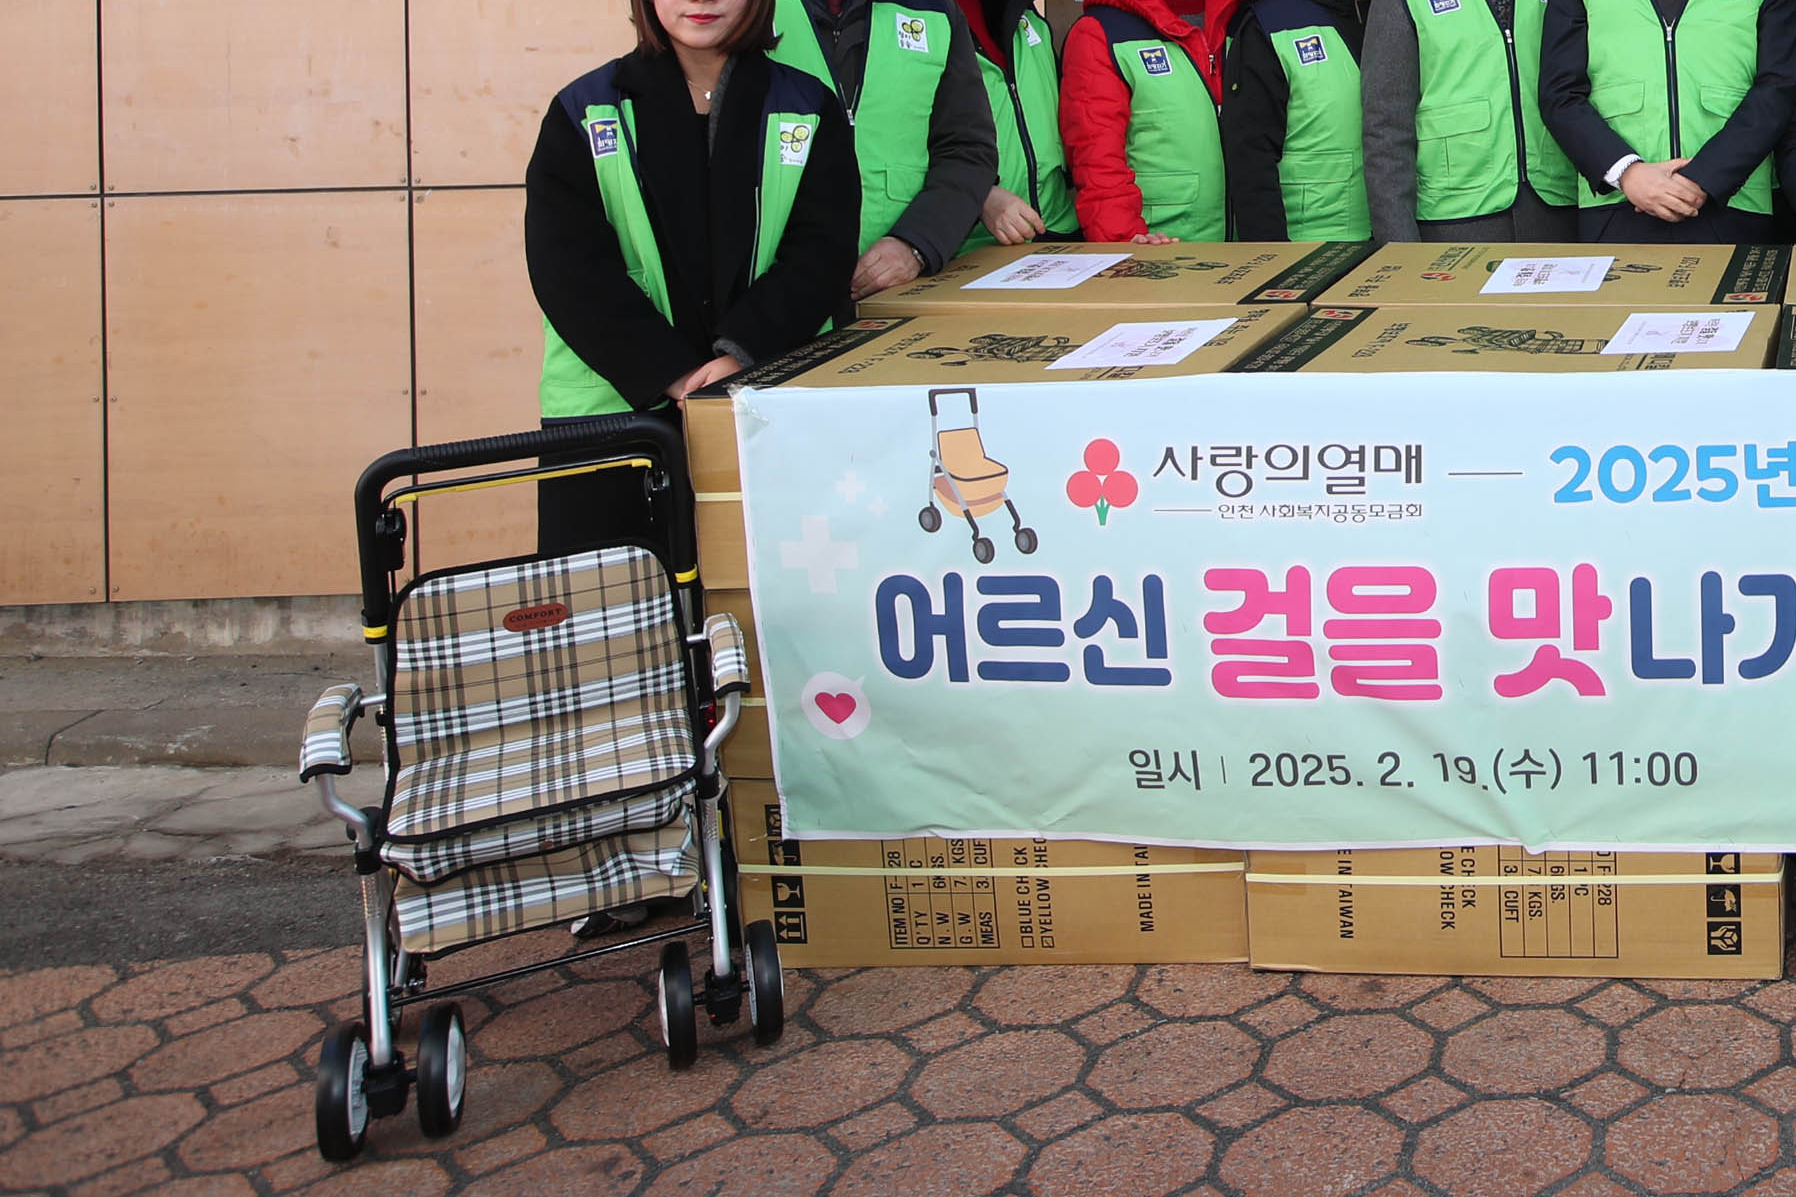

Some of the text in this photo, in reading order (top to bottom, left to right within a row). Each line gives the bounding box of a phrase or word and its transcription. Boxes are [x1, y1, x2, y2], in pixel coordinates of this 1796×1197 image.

[1152, 443, 1424, 498] 사랑의열매
[1218, 502, 1423, 523] 인천 사회복지공동모금회
[508, 608, 563, 624] COMFORT
[874, 571, 1173, 688] 어르신
[1202, 565, 1444, 701] 걸을
[1128, 748, 1201, 791] 일시
[1250, 750, 1365, 789] 2025.
[1378, 751, 1415, 789] 2.
[1580, 750, 1699, 788] 11:00
[1014, 846, 1033, 935] BLUE CHCK
[1137, 873, 1151, 888] IN
[891, 897, 906, 915] NO
[1036, 877, 1053, 934] YELLOW
[1138, 892, 1155, 932] MADE
[1505, 890, 1519, 923] CUFT
[894, 917, 908, 945] ITEM
[979, 911, 994, 945] MEAS
